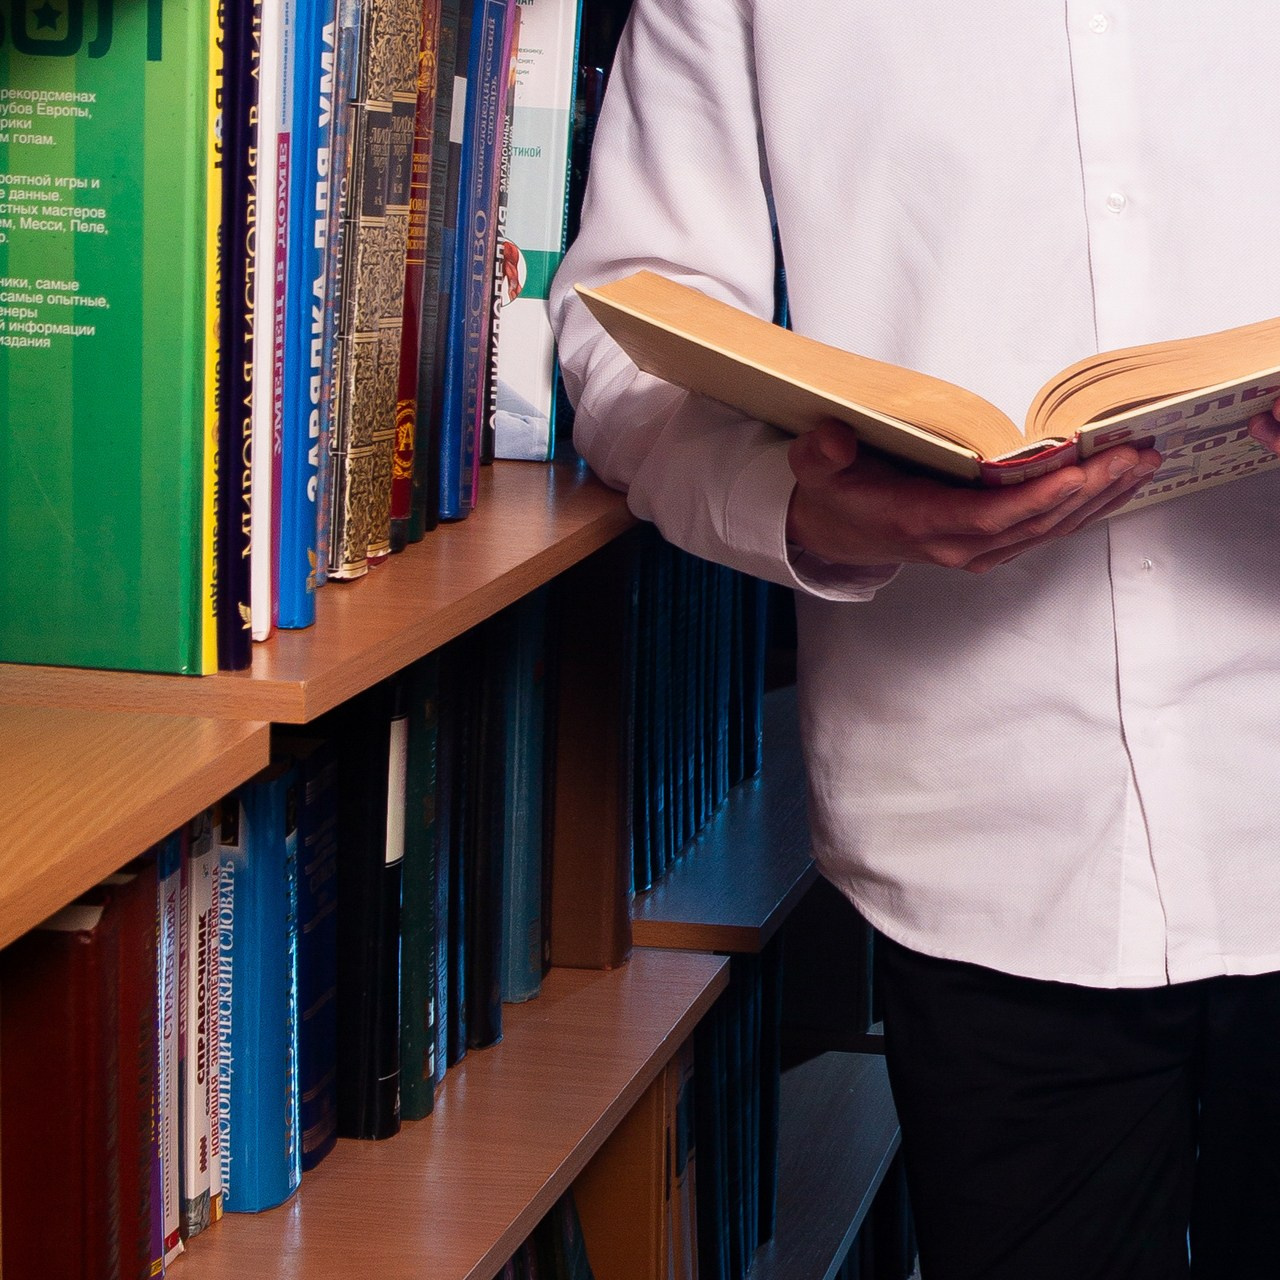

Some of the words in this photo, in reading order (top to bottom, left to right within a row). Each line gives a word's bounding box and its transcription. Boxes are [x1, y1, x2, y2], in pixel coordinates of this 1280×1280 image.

[318, 21, 335, 127] УМА
[1, 89, 96, 102] рекордсменах
[37, 104, 92, 118] Европы,
[476, 18, 495, 198] энциклопедический
[487, 76, 497, 145] словарь
[13, 134, 57, 145] голам.
[500, 115, 510, 193] ЗАГАДОЧНЫХ
[55, 178, 87, 190] игры
[92, 180, 100, 188] и
[9, 190, 62, 201] данные.
[278, 143, 287, 247] ДОМЕ
[42, 207, 105, 219] мастеров
[20, 218, 66, 232] Месси,
[70, 220, 108, 234] Пеле,
[36, 280, 79, 290] самые
[1, 293, 43, 303] самые
[47, 295, 110, 308] опытные,
[9, 322, 95, 336] информации
[274, 295, 284, 454] УМЕЛЕЦ
[221, 861, 235, 949] СЛОВАРЬ
[166, 890, 175, 946] МИРА
[197, 913, 206, 1085] СПРАВОЧНИК
[211, 1076, 219, 1156] НОВЕЙШАЯ
